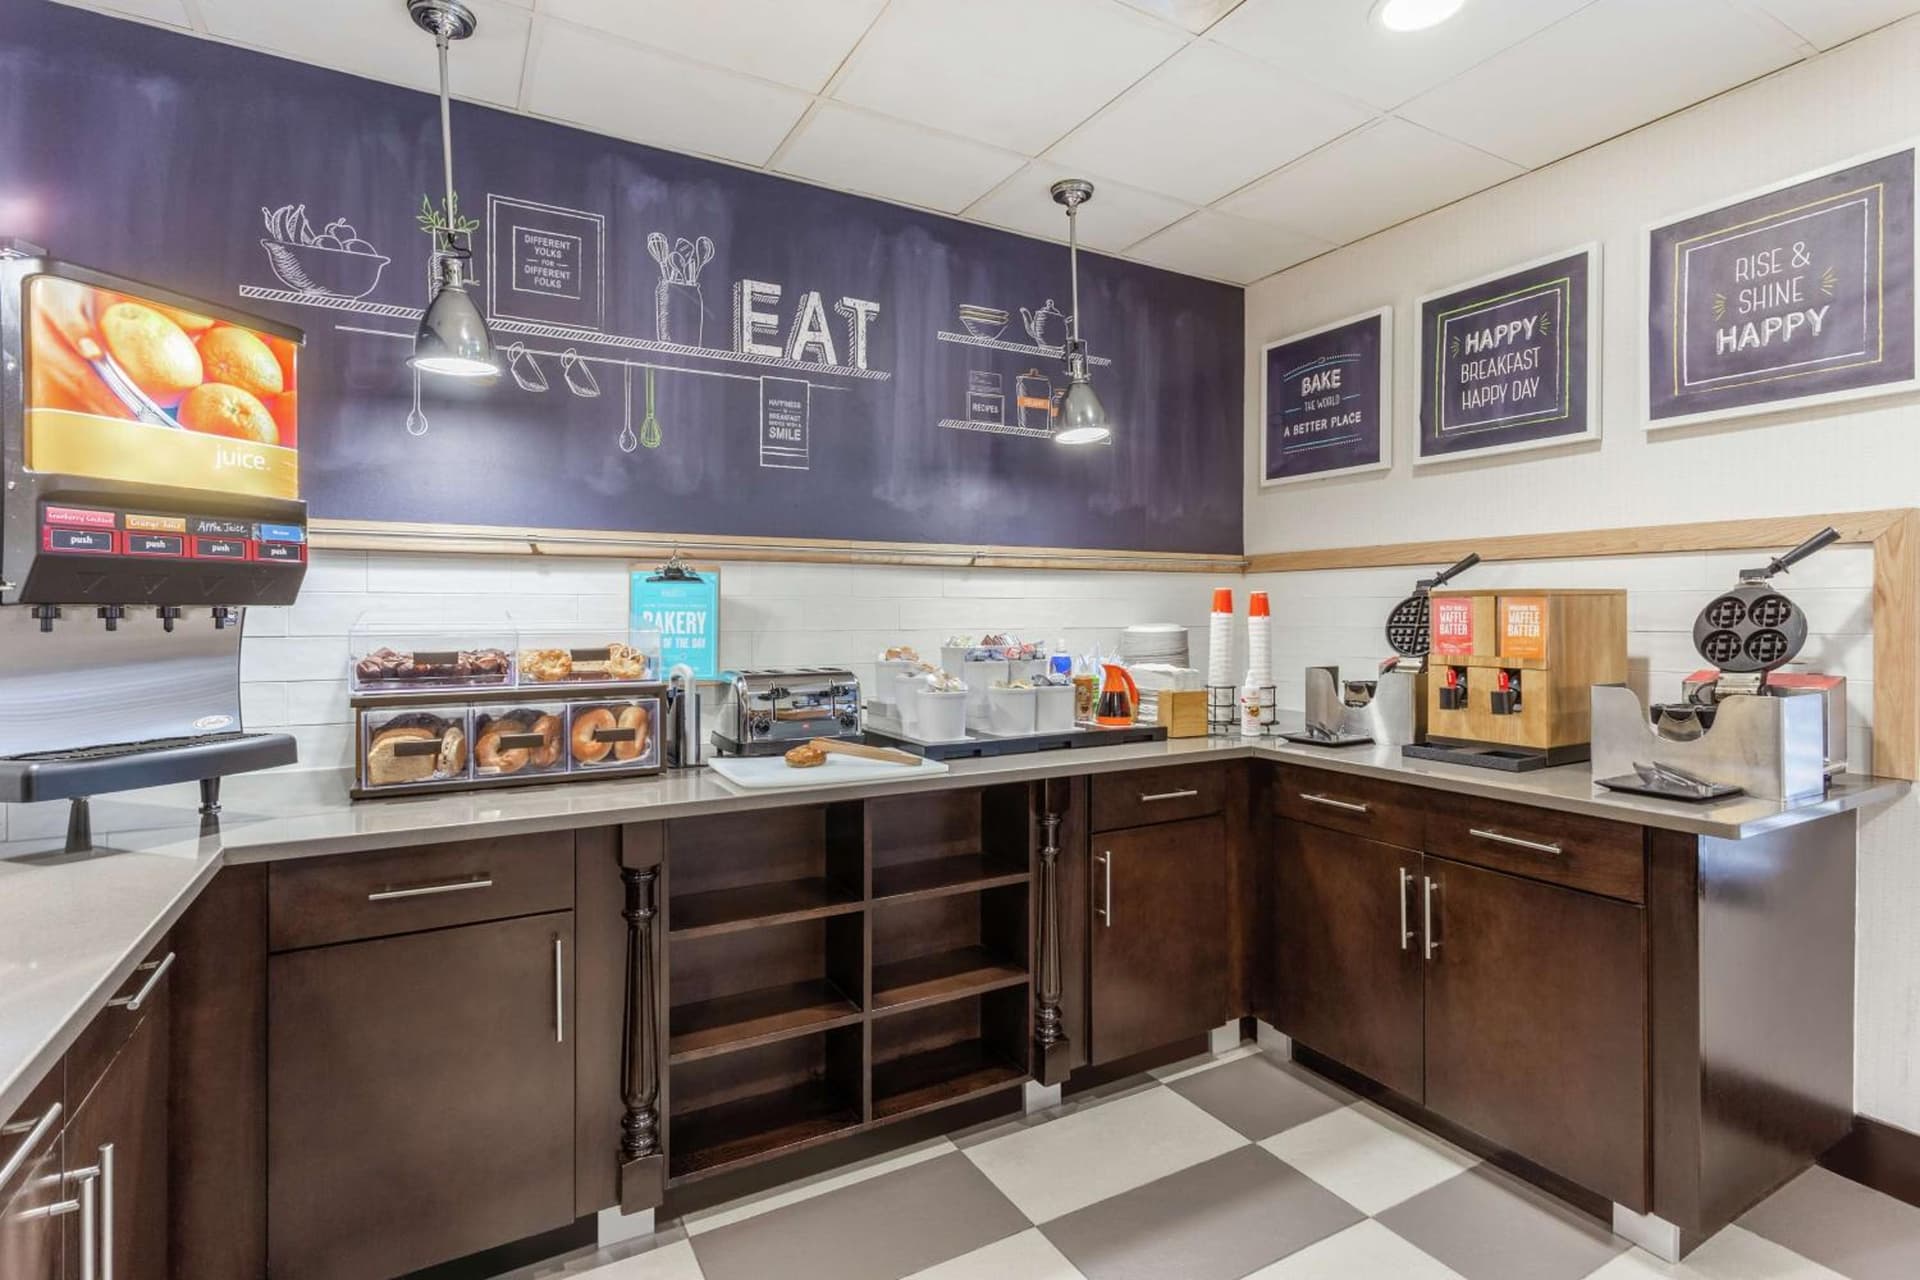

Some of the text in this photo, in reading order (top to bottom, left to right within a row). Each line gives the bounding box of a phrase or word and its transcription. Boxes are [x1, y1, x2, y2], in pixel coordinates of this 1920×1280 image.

[524, 234, 571, 250] DIFFERENT
[534, 246, 562, 259] YOLKS
[1735, 241, 1811, 283] RISE &
[524, 264, 571, 280] DIFFERENT
[534, 276, 562, 289] FOLKS
[1738, 276, 1805, 314] SHINE
[733, 279, 880, 369] EAT
[1716, 305, 1830, 355] HAPPY
[1465, 315, 1538, 355] HAPPY
[1461, 346, 1541, 384] BREAKFAST
[1301, 368, 1342, 397] BAKE
[1462, 376, 1540, 411] HAPPY DAY
[1304, 394, 1340, 412] THE WORLD
[1284, 411, 1362, 438] A BETTER PLACE
[769, 426, 801, 440] SMILE
[70, 535, 93, 545] push
[145, 539, 166, 549] push
[212, 543, 230, 552] push
[270, 547, 287, 556] push
[1439, 611, 1467, 624] WAFFLE
[1508, 611, 1540, 624] WAFFLE
[1439, 623, 1467, 636] BATTER
[1507, 624, 1540, 637] BATTER
